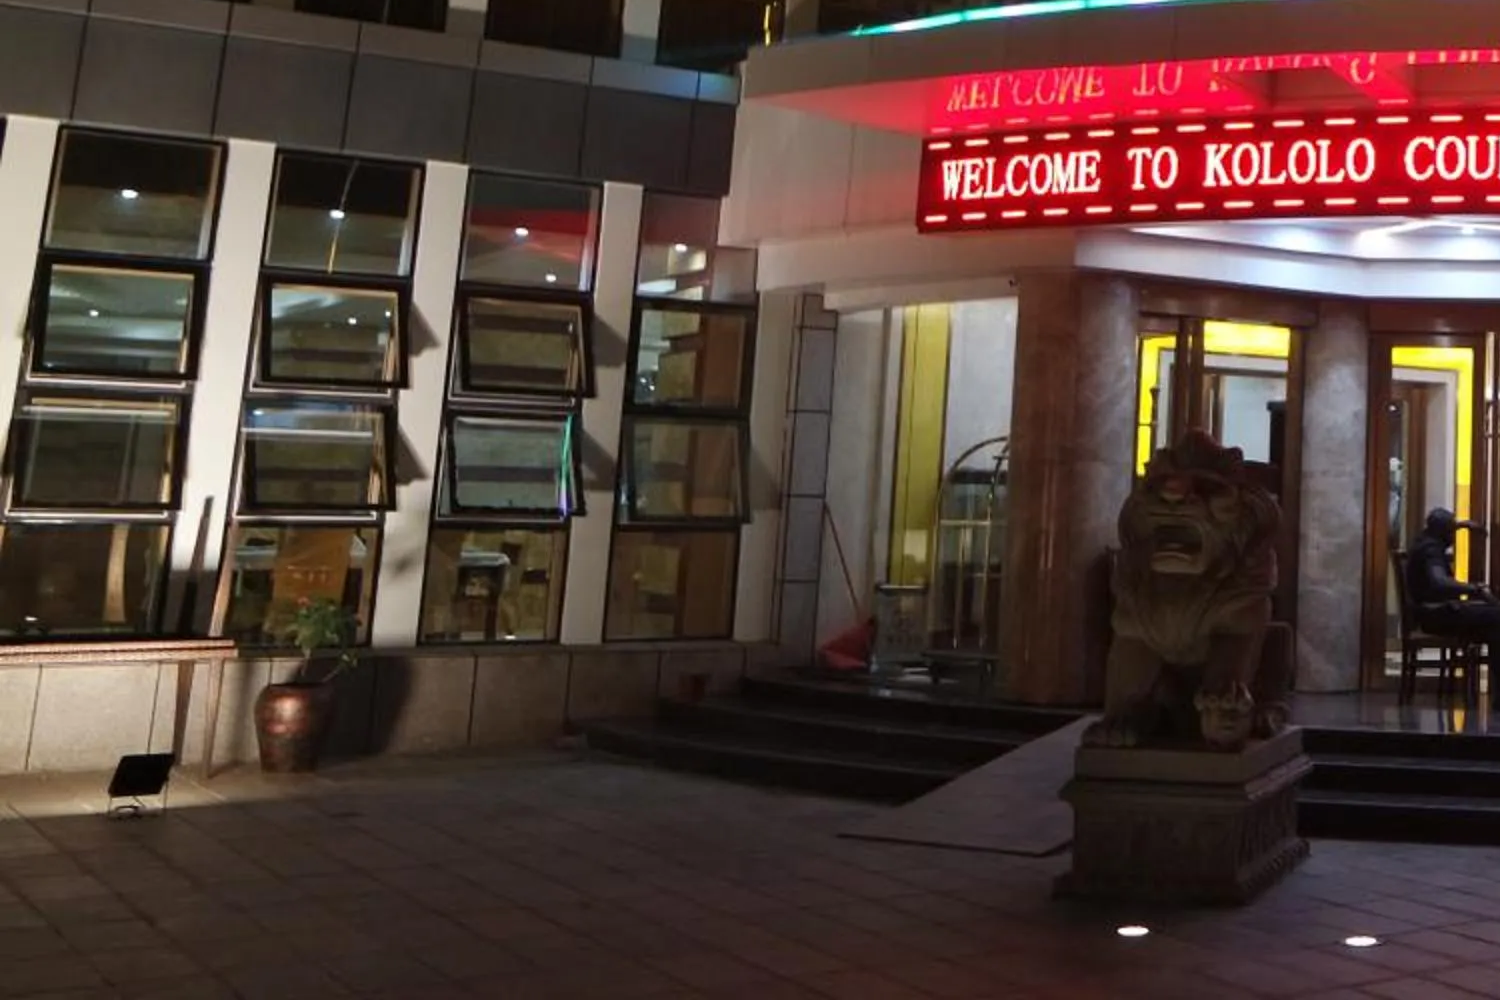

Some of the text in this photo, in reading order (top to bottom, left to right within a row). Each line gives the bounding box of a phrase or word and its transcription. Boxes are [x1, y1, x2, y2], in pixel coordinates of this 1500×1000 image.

[941, 152, 1101, 200] WELCOME
[1127, 146, 1179, 190] TO
[1203, 139, 1376, 187] KOLOLO
